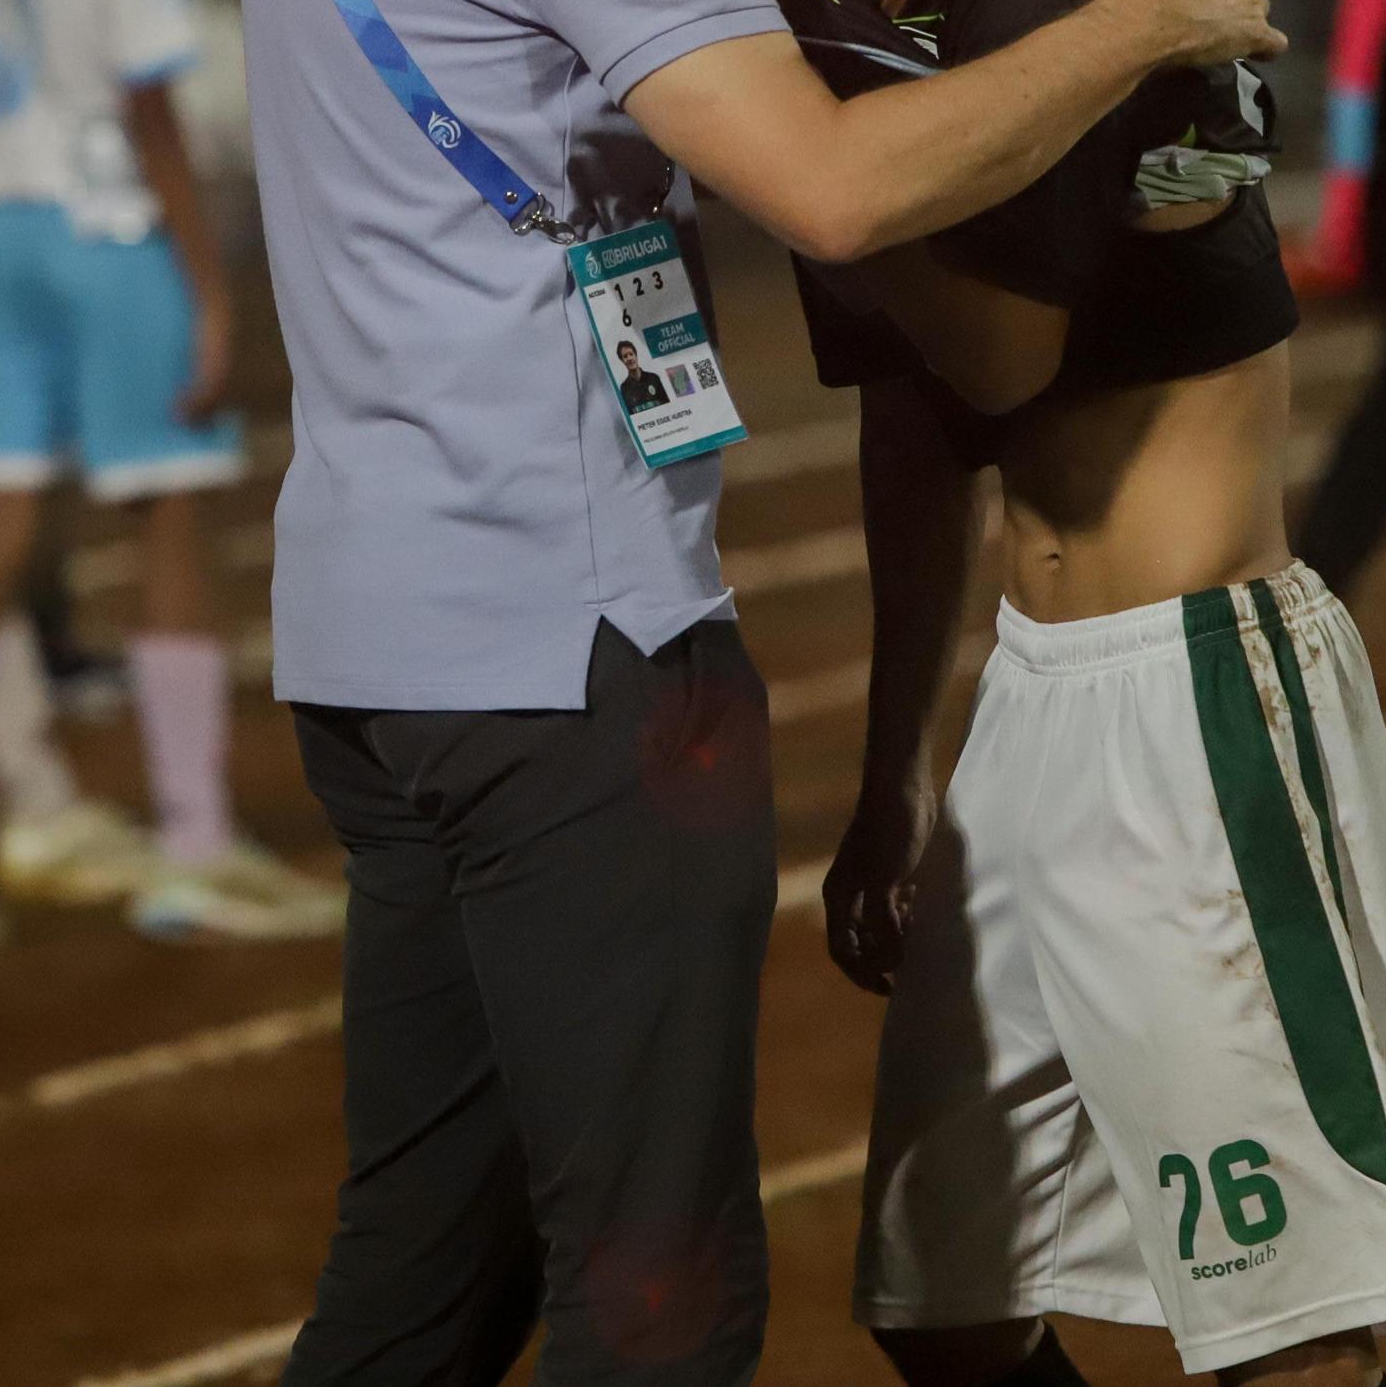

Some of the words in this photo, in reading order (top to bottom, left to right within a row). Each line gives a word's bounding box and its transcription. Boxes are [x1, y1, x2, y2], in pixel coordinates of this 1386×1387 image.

[614, 283, 624, 301] 1
[633, 277, 645, 296] 2
[652, 271, 663, 290] 3
[622, 308, 632, 327] 6
[660, 322, 685, 338] TEAM
[658, 332, 695, 352] OFFICIAL
[1191, 1244, 1277, 1280] scorelab
